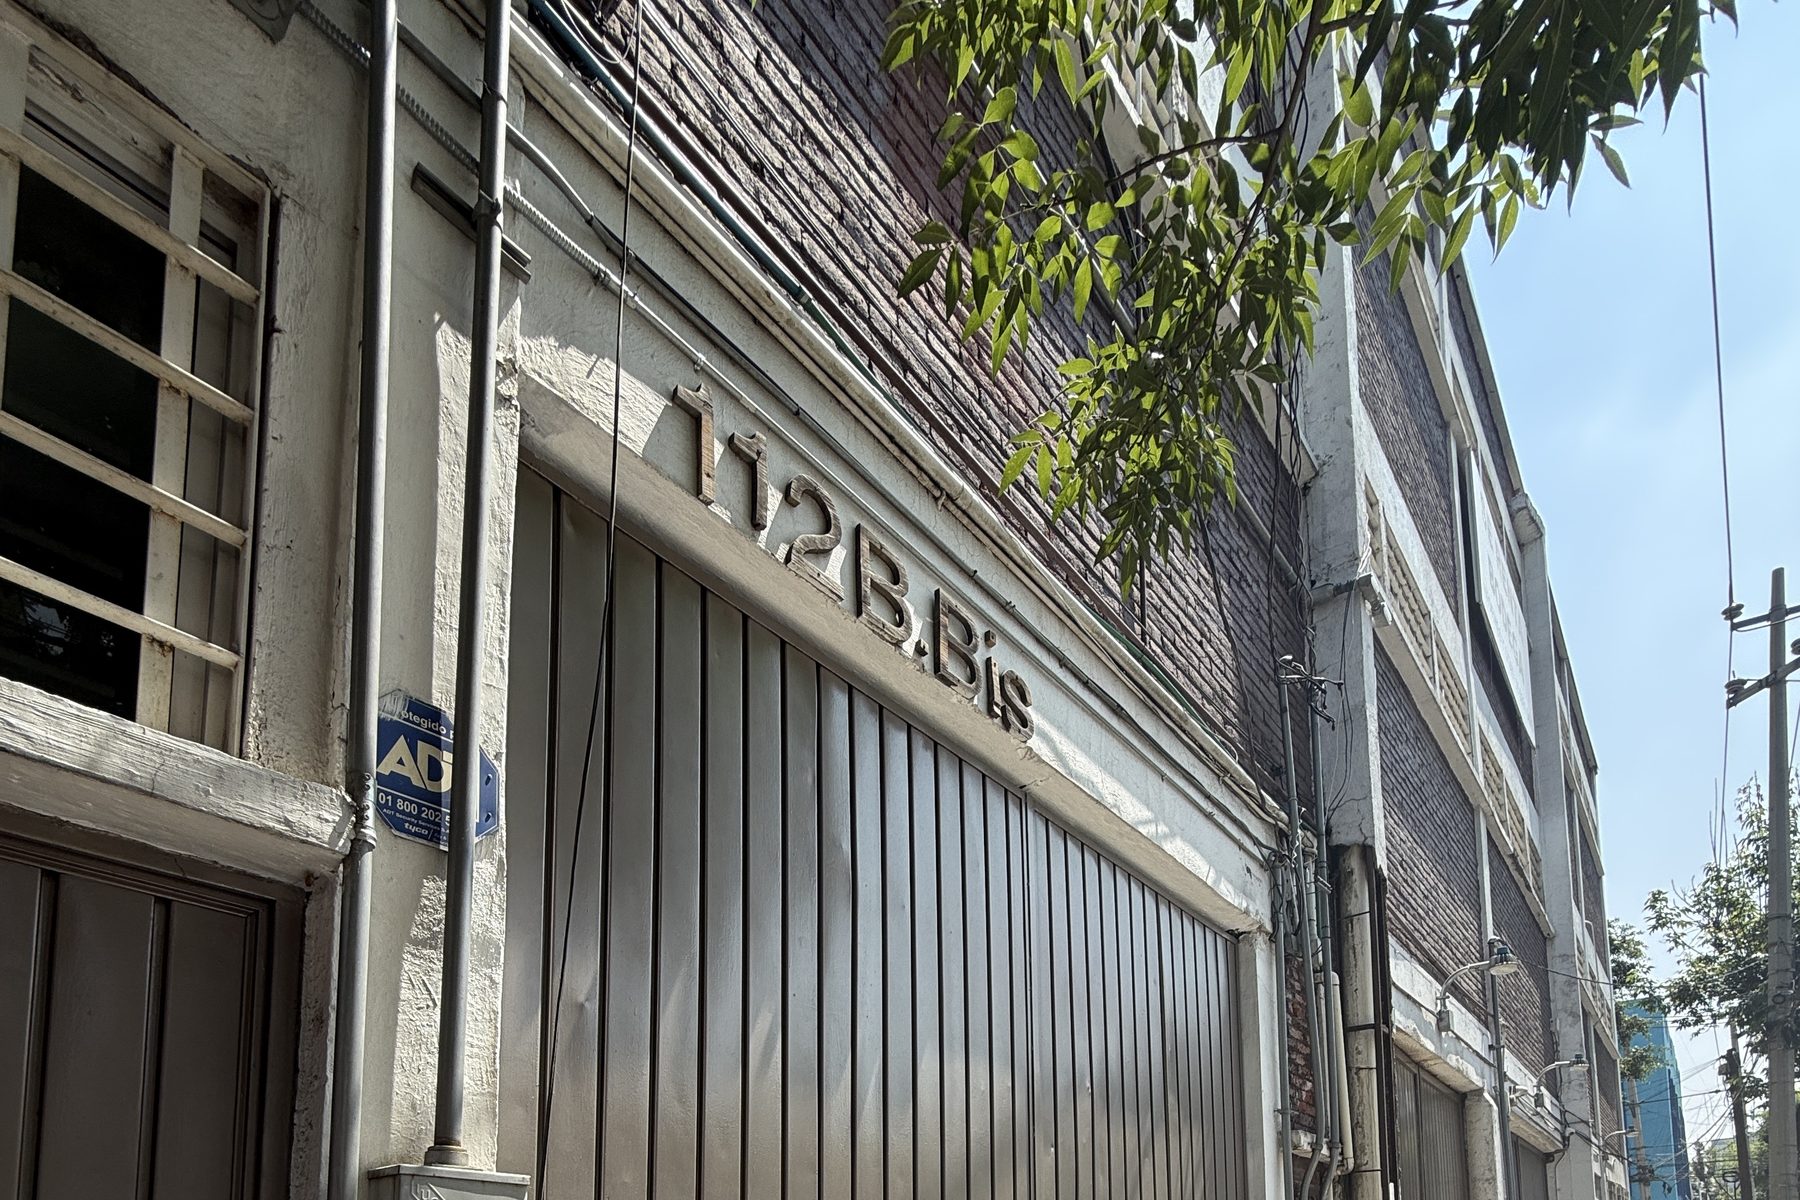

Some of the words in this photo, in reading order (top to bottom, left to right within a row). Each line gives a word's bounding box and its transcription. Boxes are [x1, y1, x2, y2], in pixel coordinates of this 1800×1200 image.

[401, 710, 447, 734] otegido
[376, 734, 453, 793] AD
[378, 792, 392, 807] 01
[396, 798, 418, 815] 800
[421, 807, 442, 823] 202
[404, 822, 429, 836] tyco
